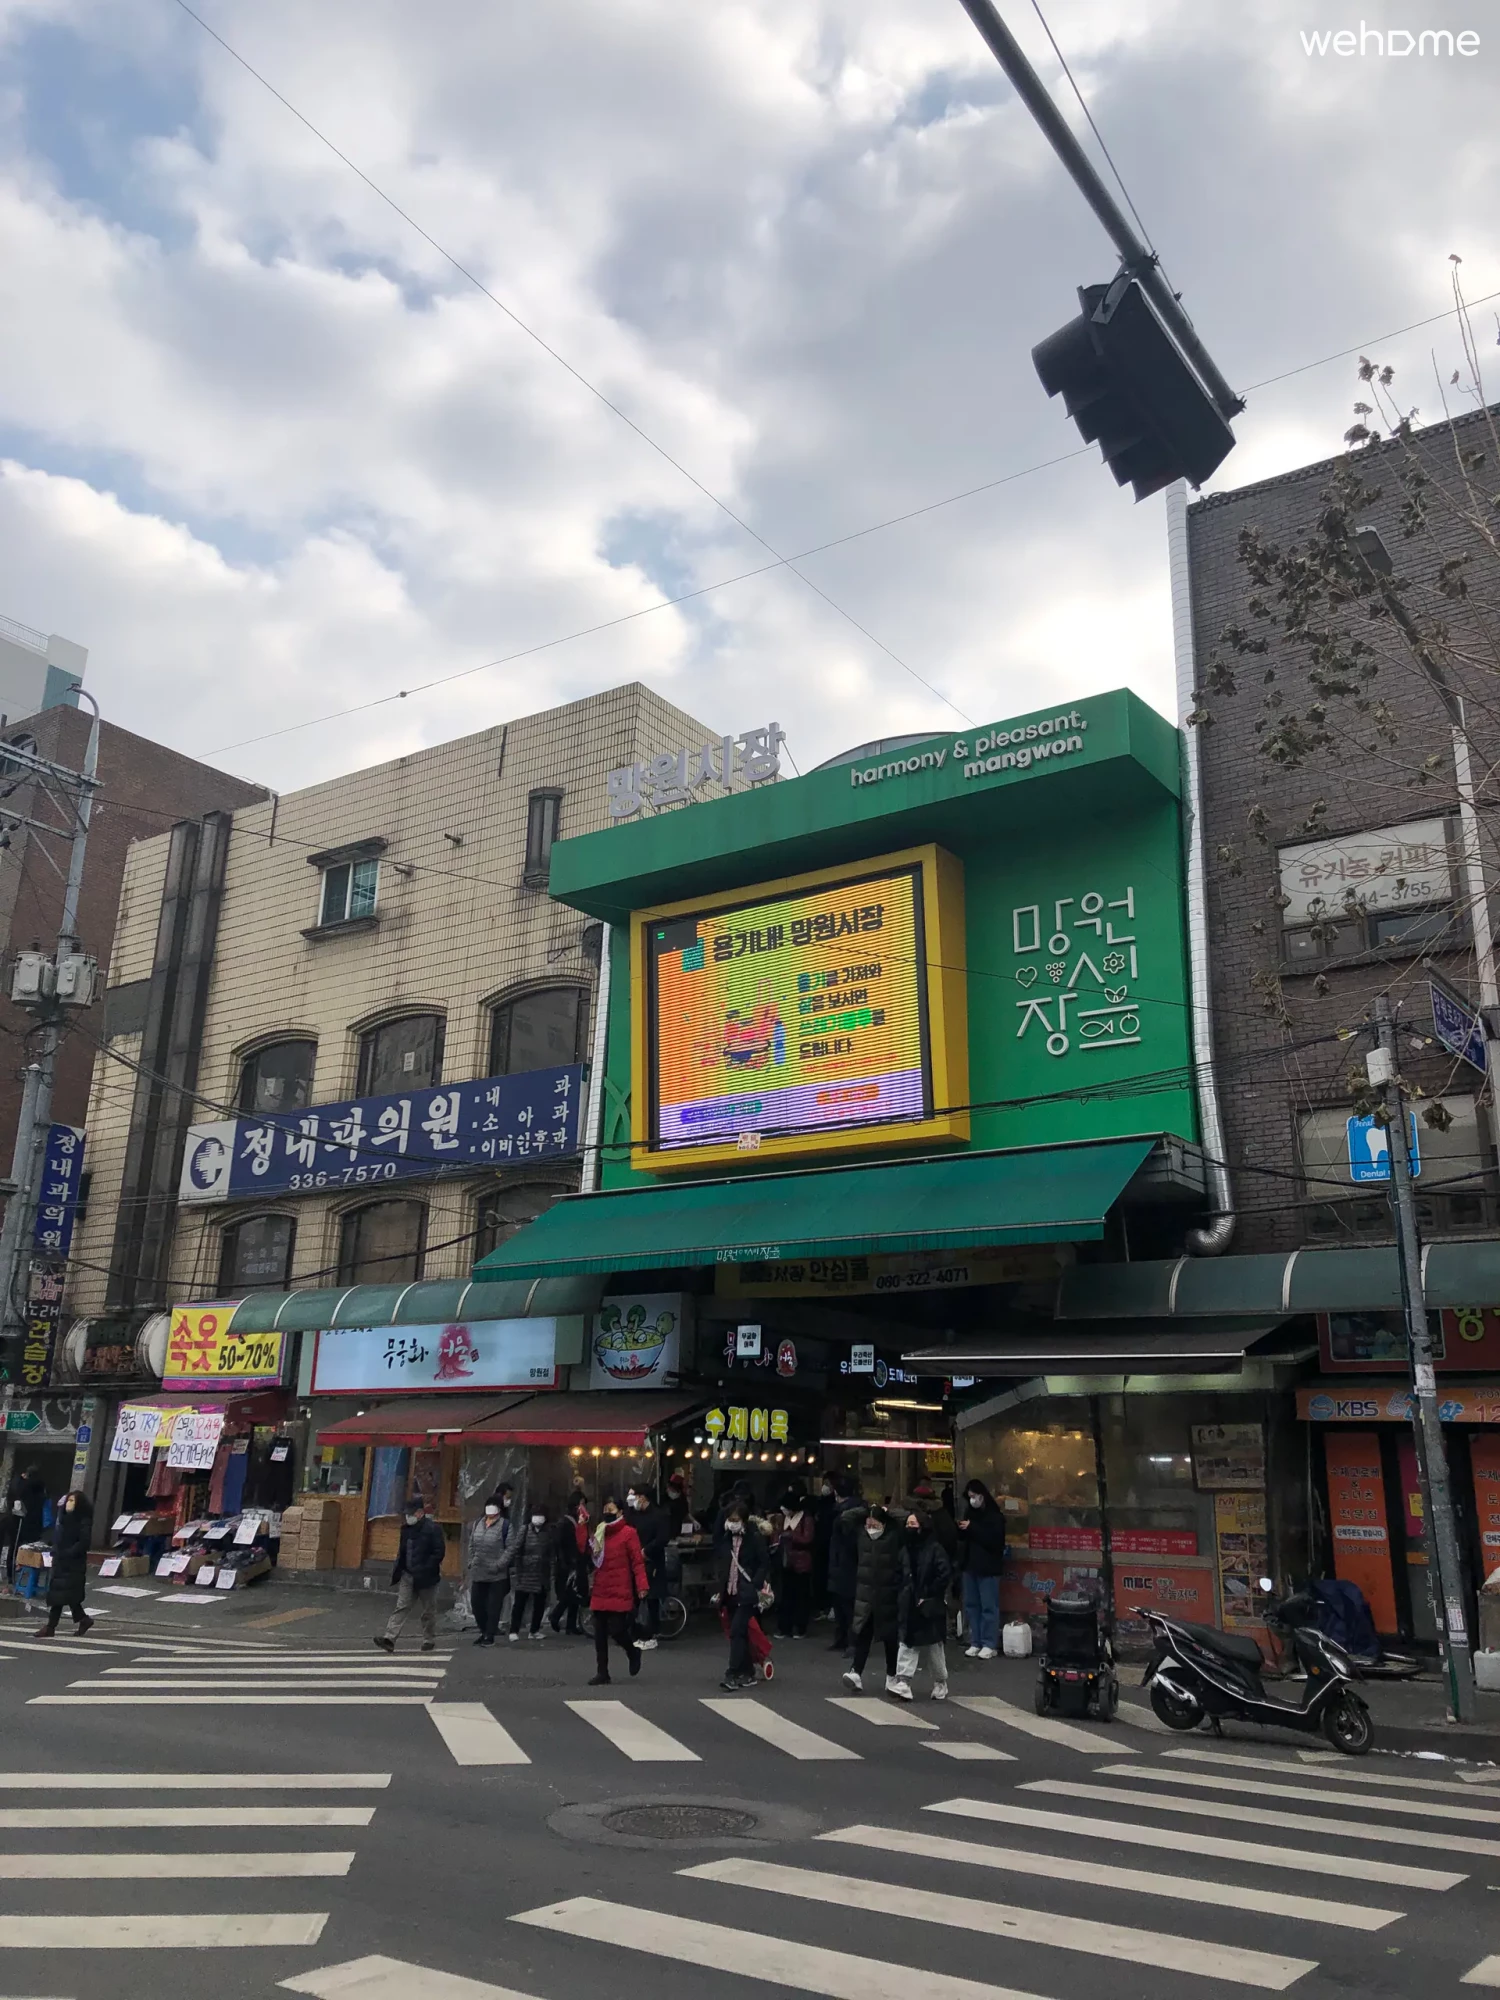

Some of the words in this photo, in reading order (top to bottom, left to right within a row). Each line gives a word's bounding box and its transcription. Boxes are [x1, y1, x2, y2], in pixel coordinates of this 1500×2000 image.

[851, 748, 947, 788] harmony
[953, 740, 969, 760] &
[975, 710, 1088, 758] pleasant,
[963, 737, 1083, 780] mangwon
[607, 721, 786, 818] 망원시장
[1299, 856, 1371, 888] 유기농
[1381, 843, 1431, 868] 커피
[791, 904, 884, 947] 망원시장
[240, 1091, 461, 1177] 정내과의원
[481, 1126, 568, 1159] 이비인후과
[288, 1162, 397, 1191] 336-7570
[1360, 1169, 1386, 1178] Dental
[170, 1314, 217, 1371] 속옷
[383, 1338, 429, 1369] 무궁화
[140, 1413, 160, 1434] TRY
[705, 1406, 788, 1444] 수제어묵
[1337, 1401, 1379, 1417] KBS
[1123, 1576, 1153, 1590] MBC
